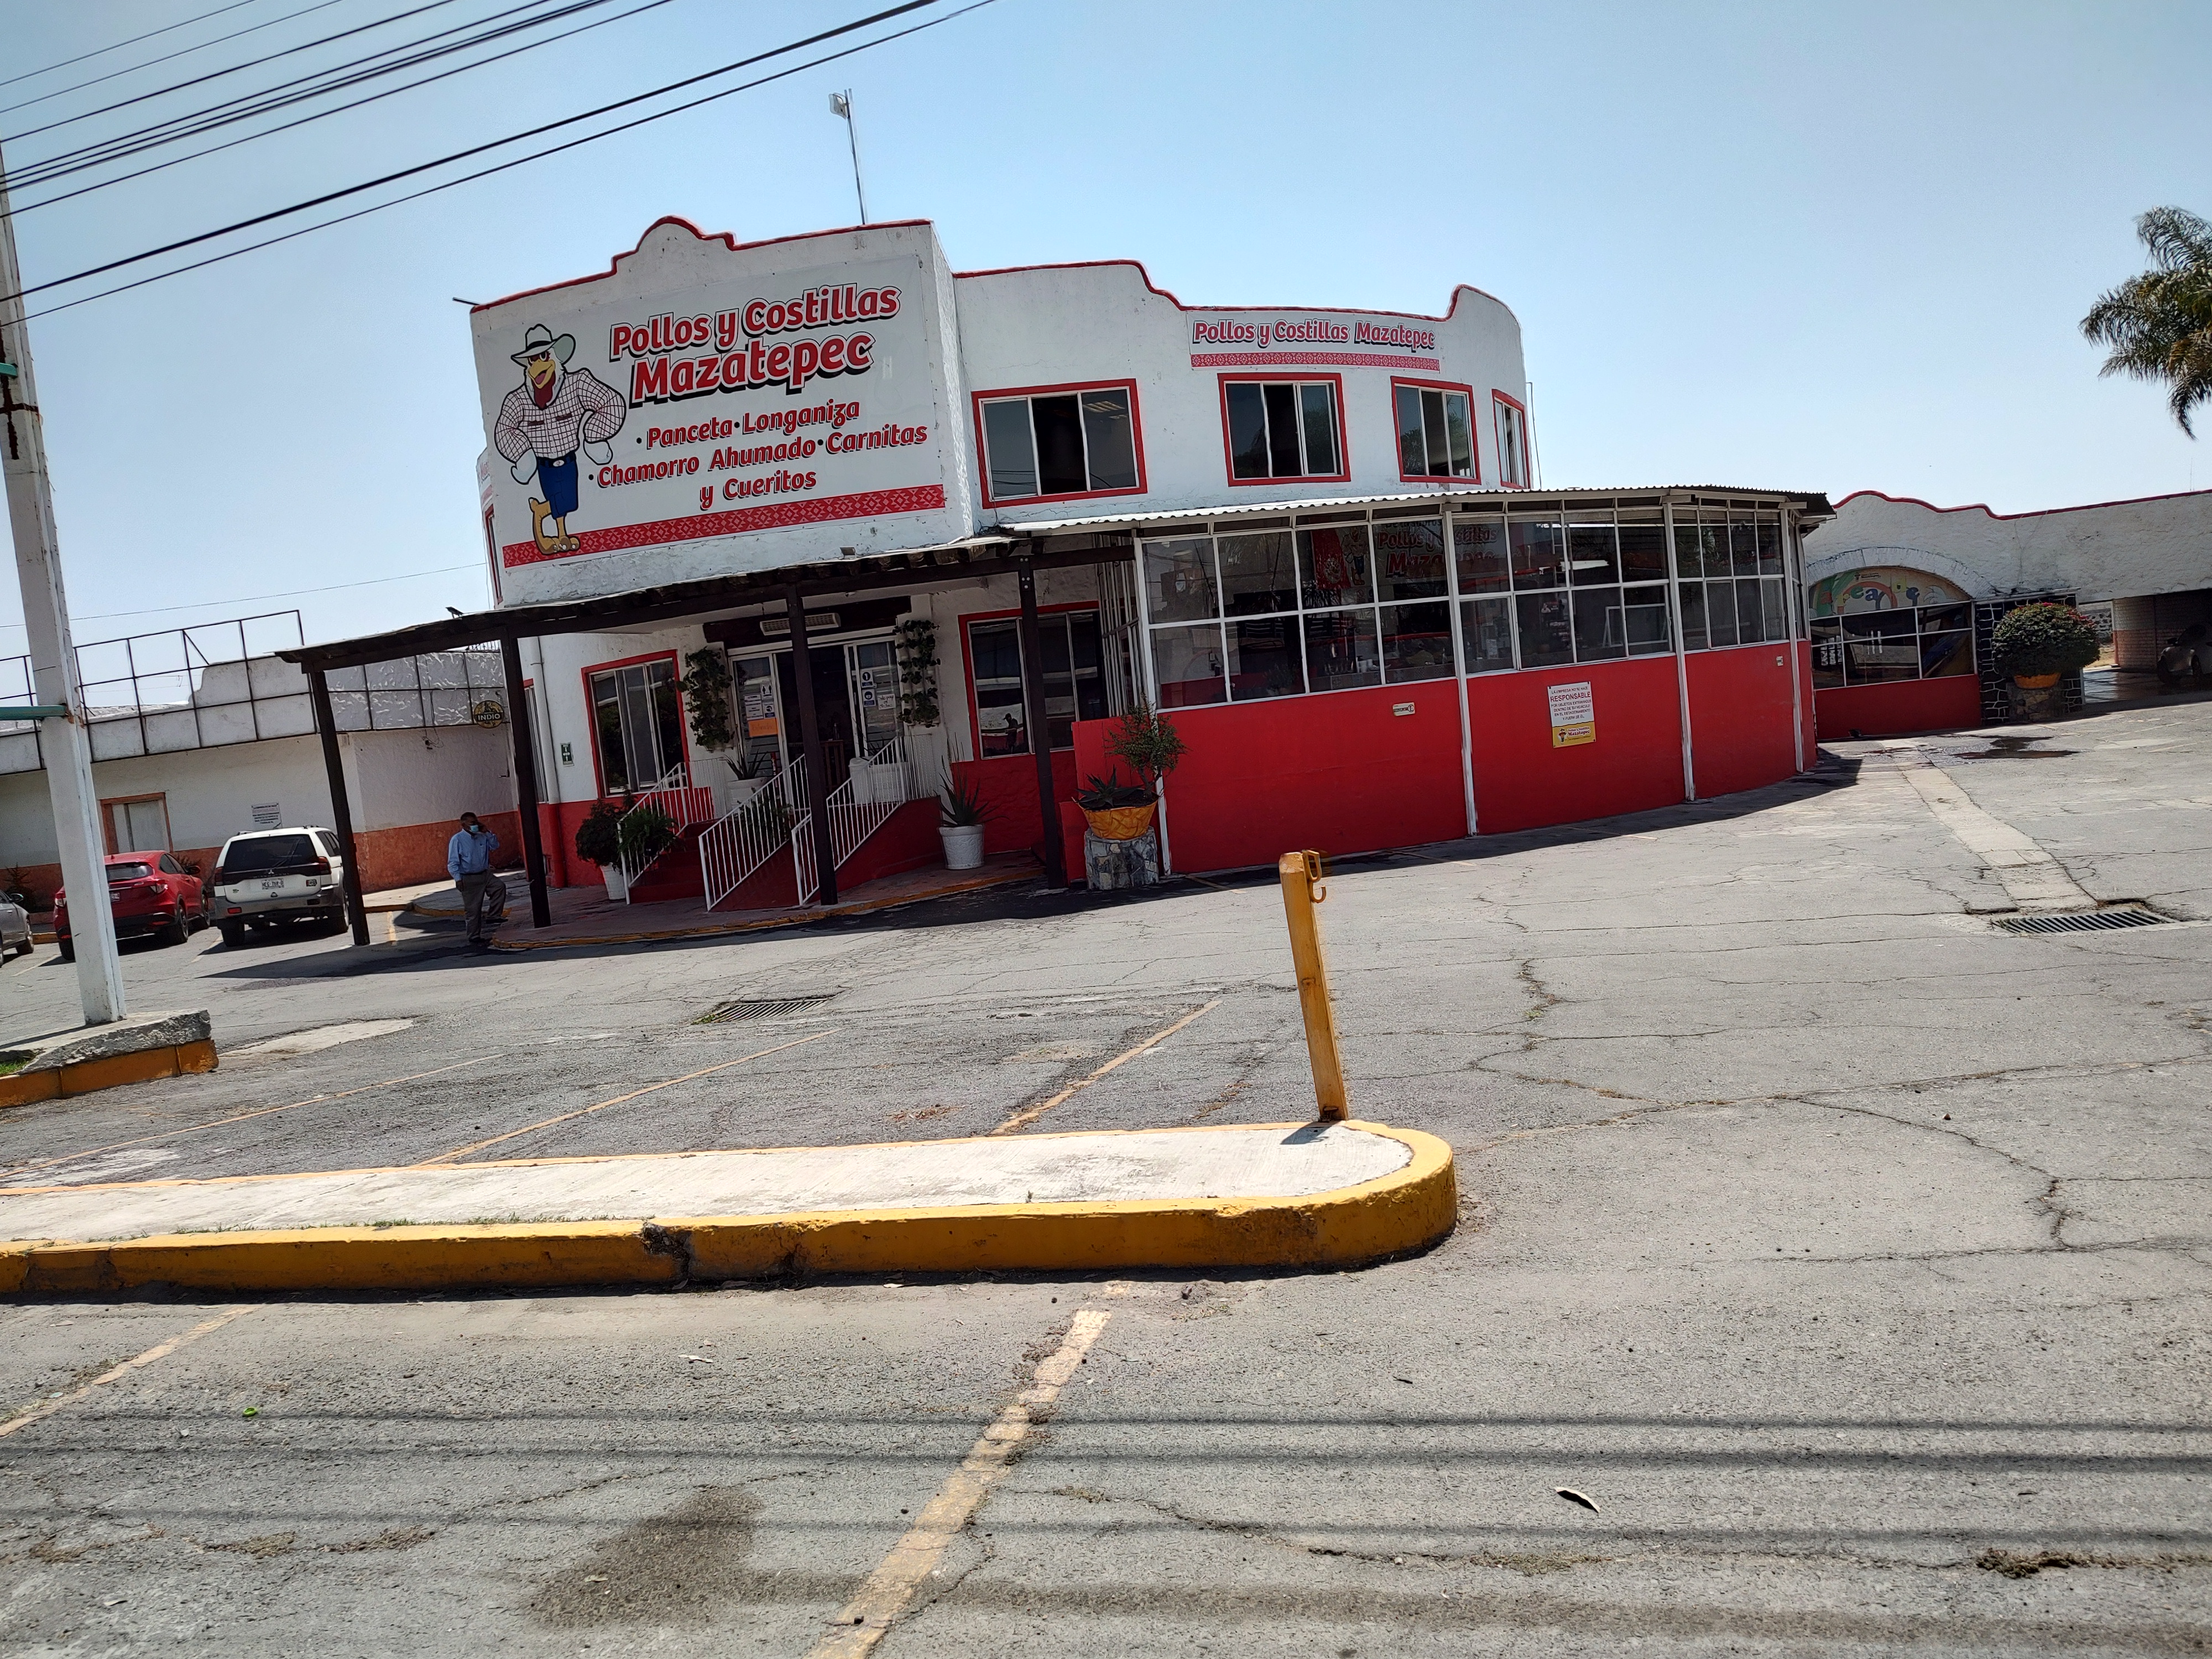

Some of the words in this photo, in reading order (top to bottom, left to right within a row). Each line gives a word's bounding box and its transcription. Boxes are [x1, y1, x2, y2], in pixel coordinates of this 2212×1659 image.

[611, 313, 711, 360] Pollos
[716, 308, 739, 352] y
[742, 283, 901, 337] Costillas
[1193, 319, 1256, 345] Pollos
[1258, 323, 1271, 347] y
[1272, 319, 1350, 343] Costillas
[1354, 320, 1436, 352] Mazatepec
[630, 332, 875, 405] Mazatepec
[647, 417, 733, 449] Panceta
[743, 399, 859, 436] Longaniza
[598, 456, 698, 488] Chamorro
[708, 436, 816, 472] Ahumado
[827, 424, 927, 455] Carnitas
[700, 485, 713, 510] y
[723, 468, 816, 501] Cueritos
[1379, 530, 1424, 549] Pollos
[1550, 692, 1590, 702] RESPONSABLE
